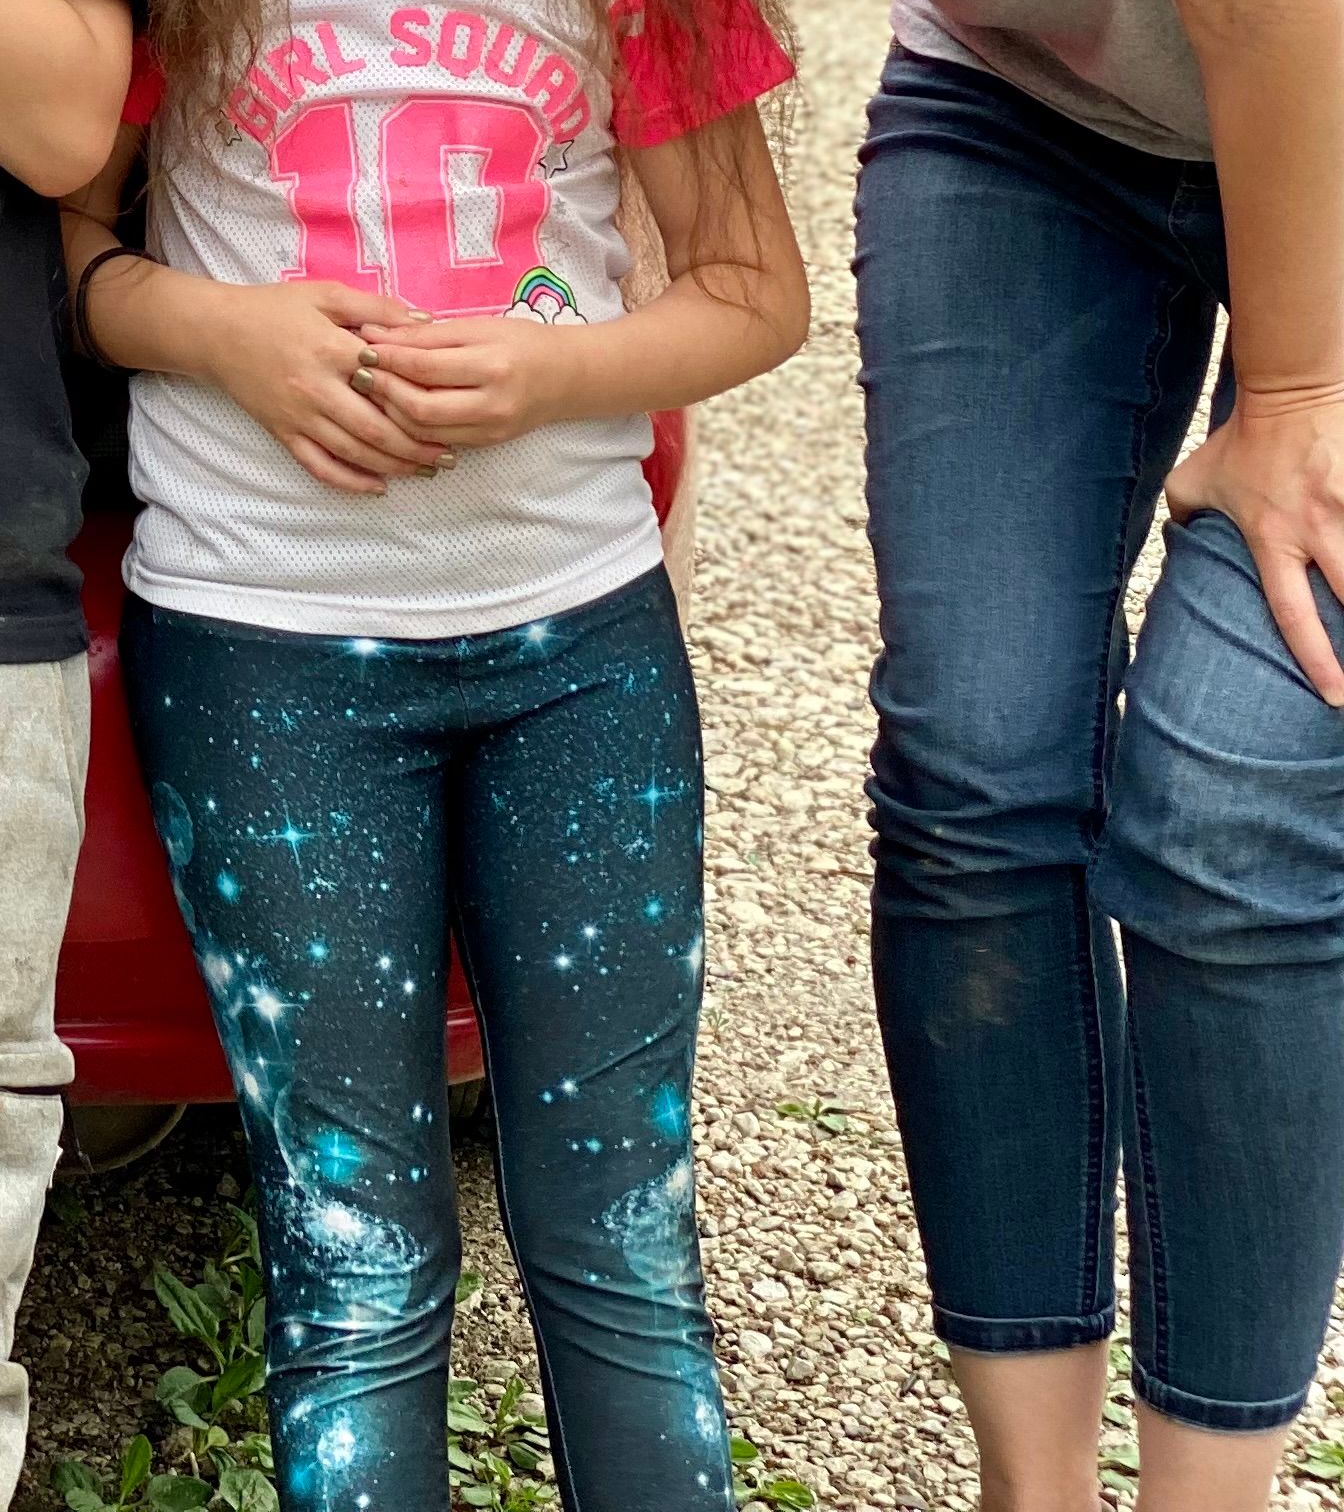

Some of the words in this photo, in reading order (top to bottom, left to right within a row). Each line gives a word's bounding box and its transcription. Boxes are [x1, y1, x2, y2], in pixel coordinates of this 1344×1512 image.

[229, 22, 366, 143] GIRL
[389, 6, 592, 144] SQUAD
[269, 96, 553, 320] 10
